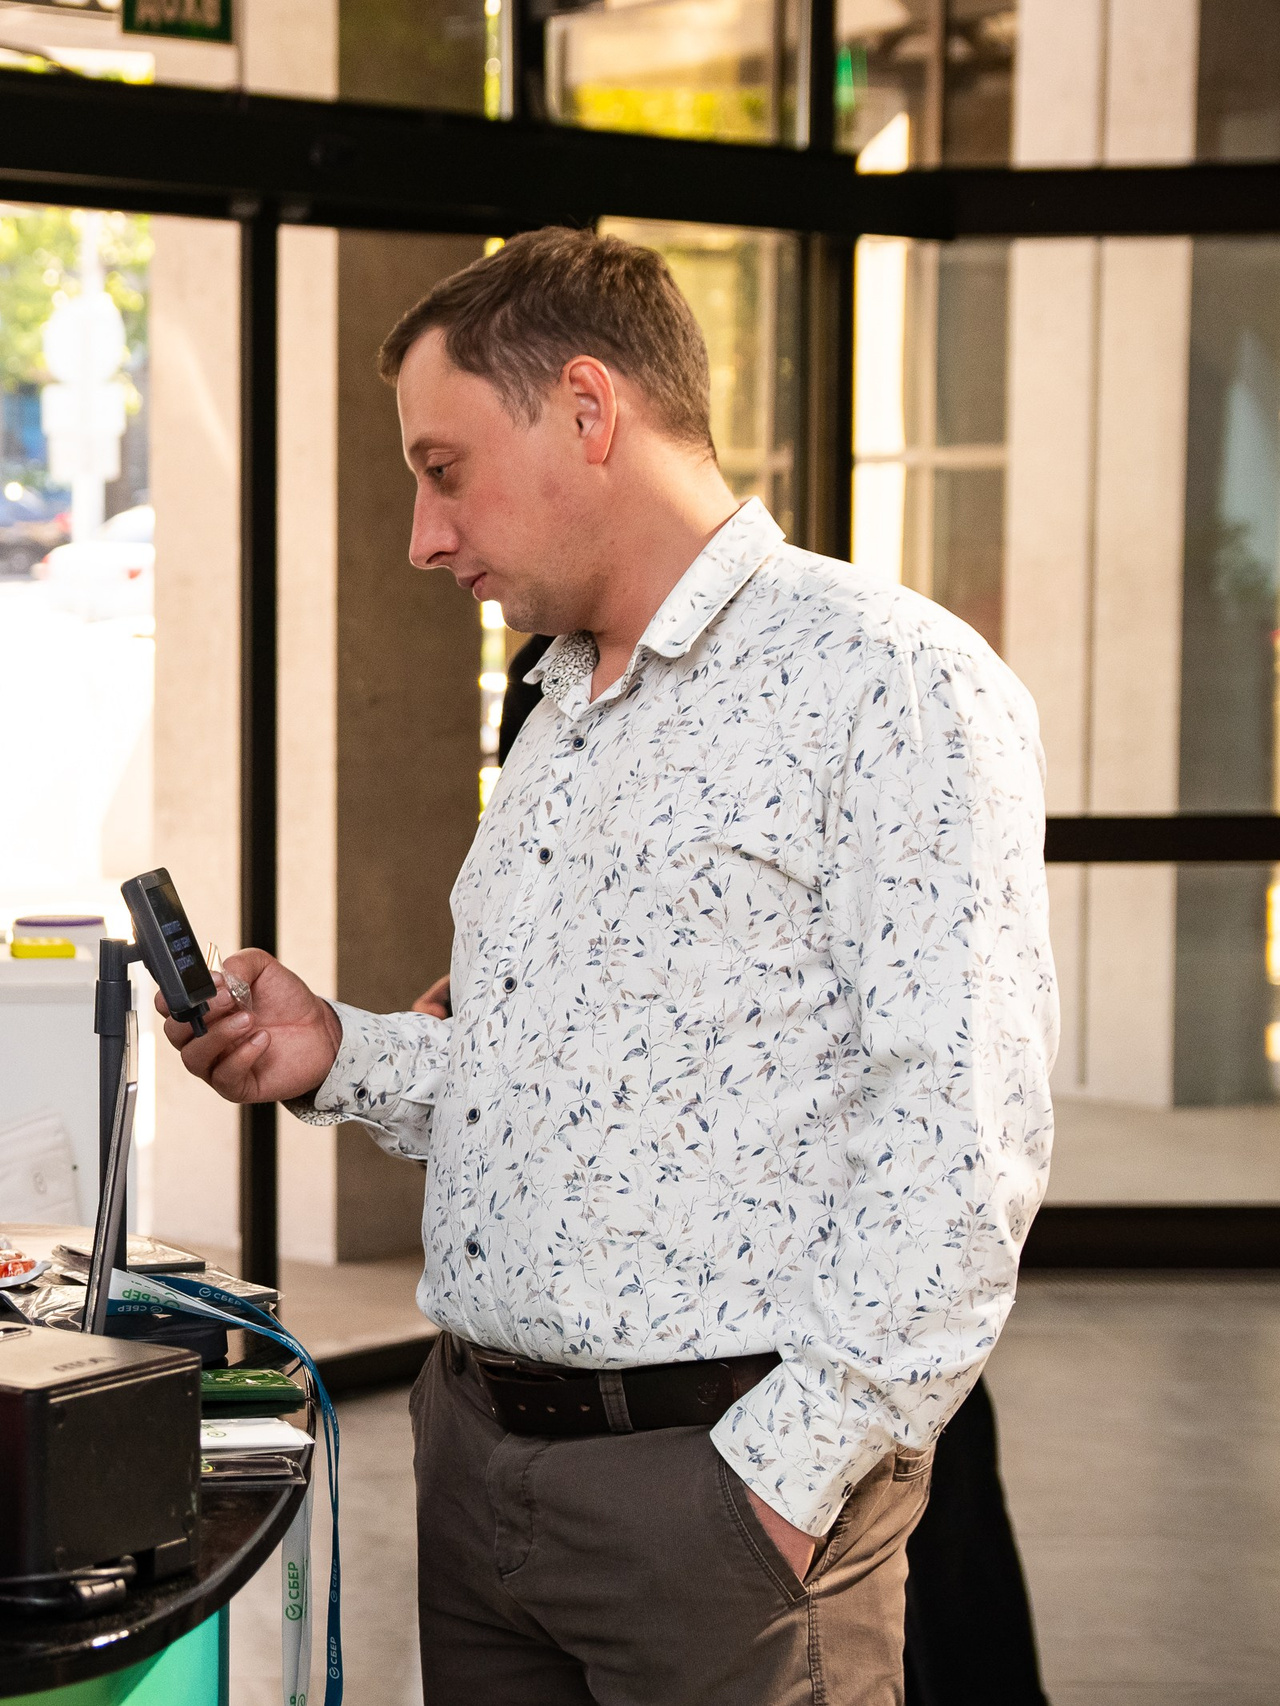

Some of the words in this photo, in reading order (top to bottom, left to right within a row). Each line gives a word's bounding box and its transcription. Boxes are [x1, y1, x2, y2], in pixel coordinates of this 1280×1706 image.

[213, 1292, 242, 1306] СБЕР
[287, 1561, 300, 1600] СБЕР
[330, 1636, 338, 1665] СБЕР
